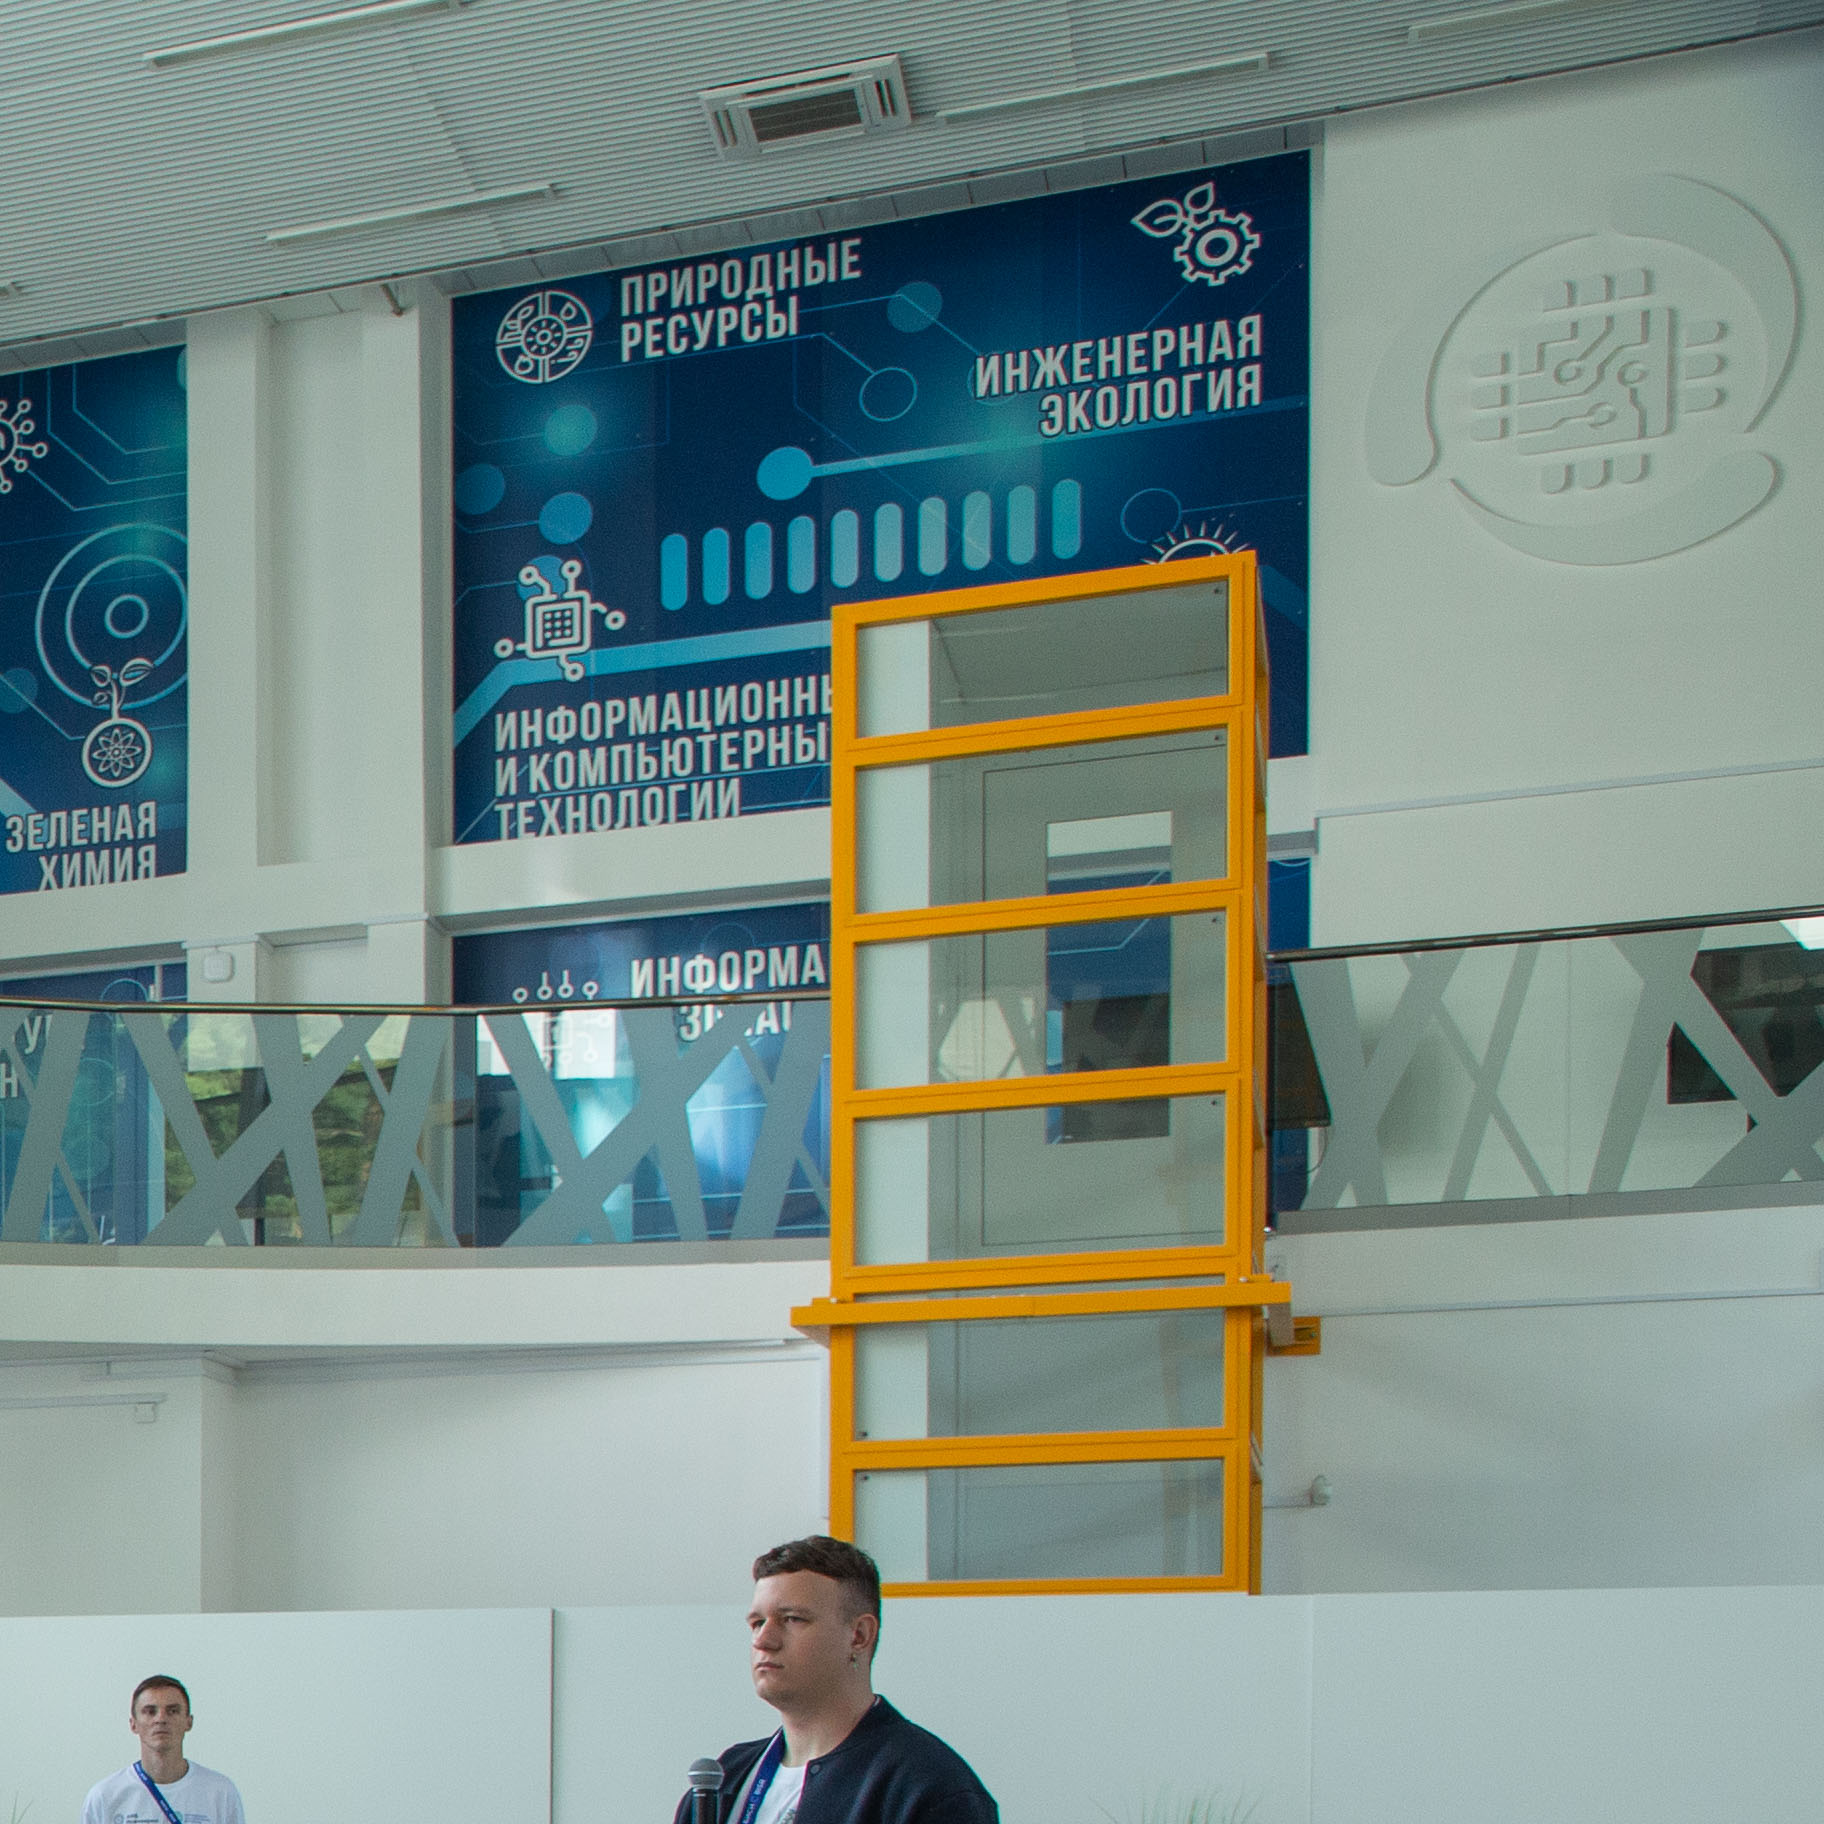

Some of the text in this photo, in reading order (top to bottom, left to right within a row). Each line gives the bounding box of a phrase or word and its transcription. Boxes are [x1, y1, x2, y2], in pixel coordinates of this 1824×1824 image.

[620, 237, 863, 318] ПРИРОДНЫЕ
[620, 296, 800, 364] РЕСУРСЫ
[975, 314, 1263, 399] ИНЖЕНЕРНАЯ
[1039, 365, 1263, 437] ЭКОЛОГИЯ
[495, 722, 827, 799] И КОМПЬЮТЕРНЫ
[5, 800, 157, 854] ЗЕЛЕНАЯ
[495, 778, 742, 843] ТЕХНОЛОГИИ
[37, 844, 157, 893] ХИМИЯ
[631, 943, 826, 999] ИНФОРМА
